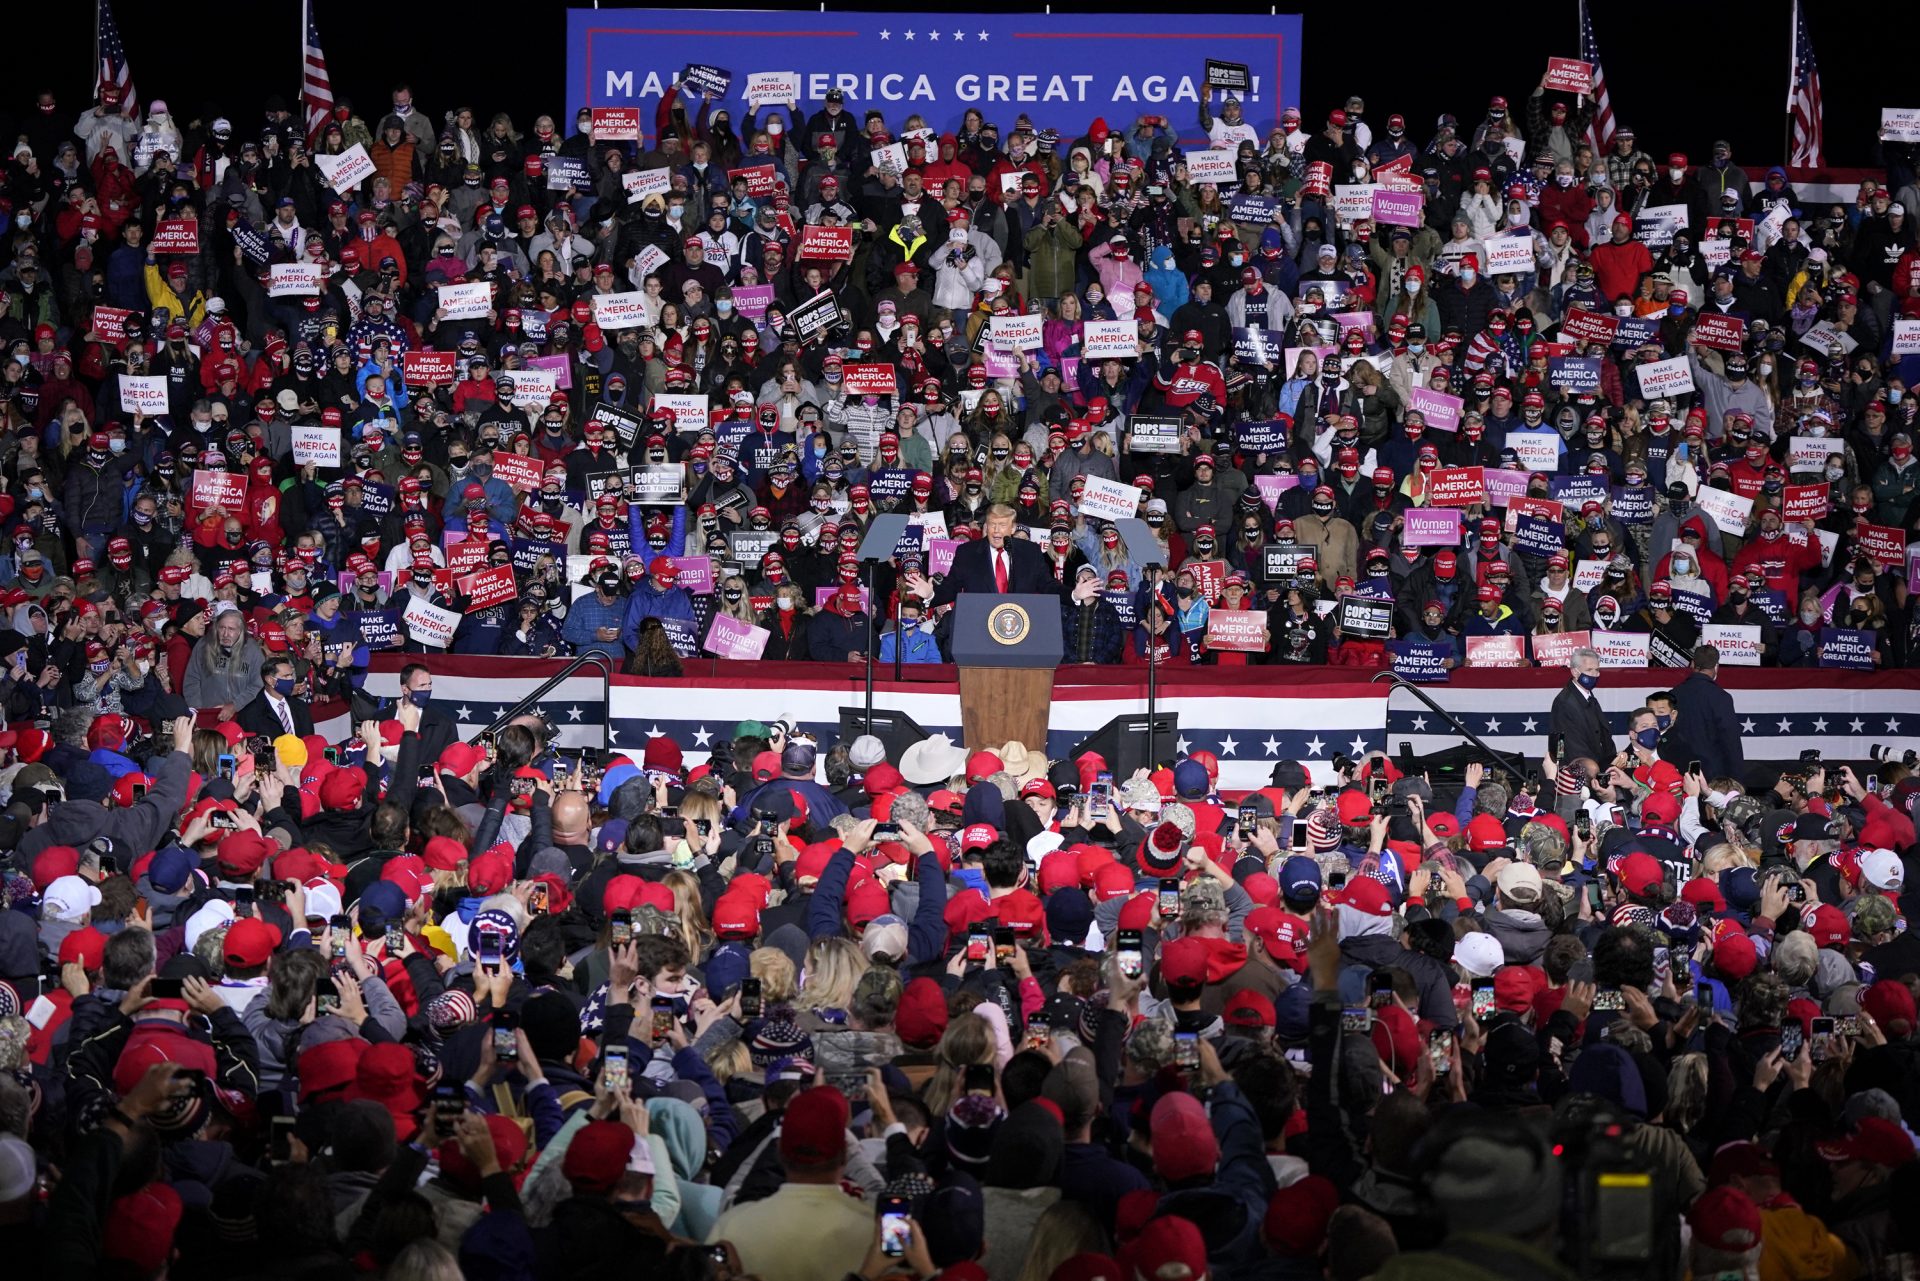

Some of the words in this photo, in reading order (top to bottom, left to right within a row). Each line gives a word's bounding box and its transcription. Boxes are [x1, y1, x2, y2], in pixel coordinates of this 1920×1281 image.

[700, 65, 717, 74] MAKE
[1210, 67, 1229, 78] COPS
[1551, 69, 1588, 81] AMERICA
[689, 68, 727, 86] AMERICA
[751, 84, 791, 92] AMERICA
[955, 74, 1093, 102] GREAT
[594, 119, 637, 127] AMERICA
[336, 155, 353, 167] MAKE
[1191, 162, 1232, 170] AMERICA
[331, 155, 366, 181] AMERICA
[627, 174, 667, 189] AMERICA
[636, 173, 654, 181] MAKE
[1378, 198, 1415, 212] Women
[155, 232, 195, 240] AMERICA
[247, 231, 264, 246] MAKE
[235, 227, 270, 257] AMERICA
[805, 239, 849, 247] AMERICA
[1490, 250, 1531, 259] AMERICA
[274, 275, 316, 283] AMERICA
[443, 297, 488, 306] AMERICA
[733, 296, 769, 306] Women
[598, 305, 643, 314] AMERICA
[797, 309, 819, 327] COPS
[802, 323, 817, 332] FOR
[817, 312, 837, 326] TRUMP
[1583, 315, 1603, 324] MAKE
[1567, 318, 1614, 334] AMERICA
[1696, 325, 1741, 337] AMERICA
[994, 328, 1039, 337] AMERICA
[1088, 334, 1134, 342] AMERICA
[1235, 341, 1279, 351] AMERICA
[1552, 370, 1597, 379] AMERICA
[1653, 365, 1672, 373] MAKE
[1643, 371, 1688, 385] AMERICA
[1176, 379, 1209, 392] ERIE
[122, 390, 163, 398] AMERICA
[1416, 398, 1455, 415] Women
[596, 410, 619, 423] COPS
[1134, 423, 1158, 434] COPS
[1239, 433, 1284, 442] AMERICA
[295, 442, 336, 450] AMERICA
[508, 459, 527, 467] MAKE
[494, 464, 540, 479] AMERICA
[210, 478, 231, 486] MAKE
[634, 473, 659, 483] COPS
[197, 485, 243, 497] AMERICA
[1102, 485, 1123, 496] MAKE
[1433, 480, 1482, 491] AMERICA
[195, 494, 218, 503] GREAT
[1086, 490, 1133, 509] AMERICA
[1459, 490, 1483, 498] AGAIN
[1786, 496, 1827, 507] AMERICA
[1083, 501, 1104, 511] GREAT
[1106, 506, 1132, 518] AGAIN
[1411, 519, 1453, 529] Women
[1530, 523, 1548, 532] MAKE
[1517, 529, 1561, 544] AMERICA
[1869, 530, 1888, 539] MAKE
[735, 540, 760, 552] COPS
[1860, 537, 1901, 550] AMERICA
[1267, 554, 1293, 565] COPS
[476, 575, 497, 585] MAKE
[424, 609, 444, 622] MAKE
[1344, 607, 1372, 620] COPS
[406, 611, 452, 634] AMERICA
[1344, 618, 1359, 627] FOR
[1361, 621, 1388, 629] TRUMP
[1212, 625, 1262, 633] AMERICA
[718, 624, 758, 649] Women
[1596, 648, 1645, 656] AMERICA
[1824, 644, 1871, 653] AMERICA
[1471, 651, 1521, 659] AMERICA
